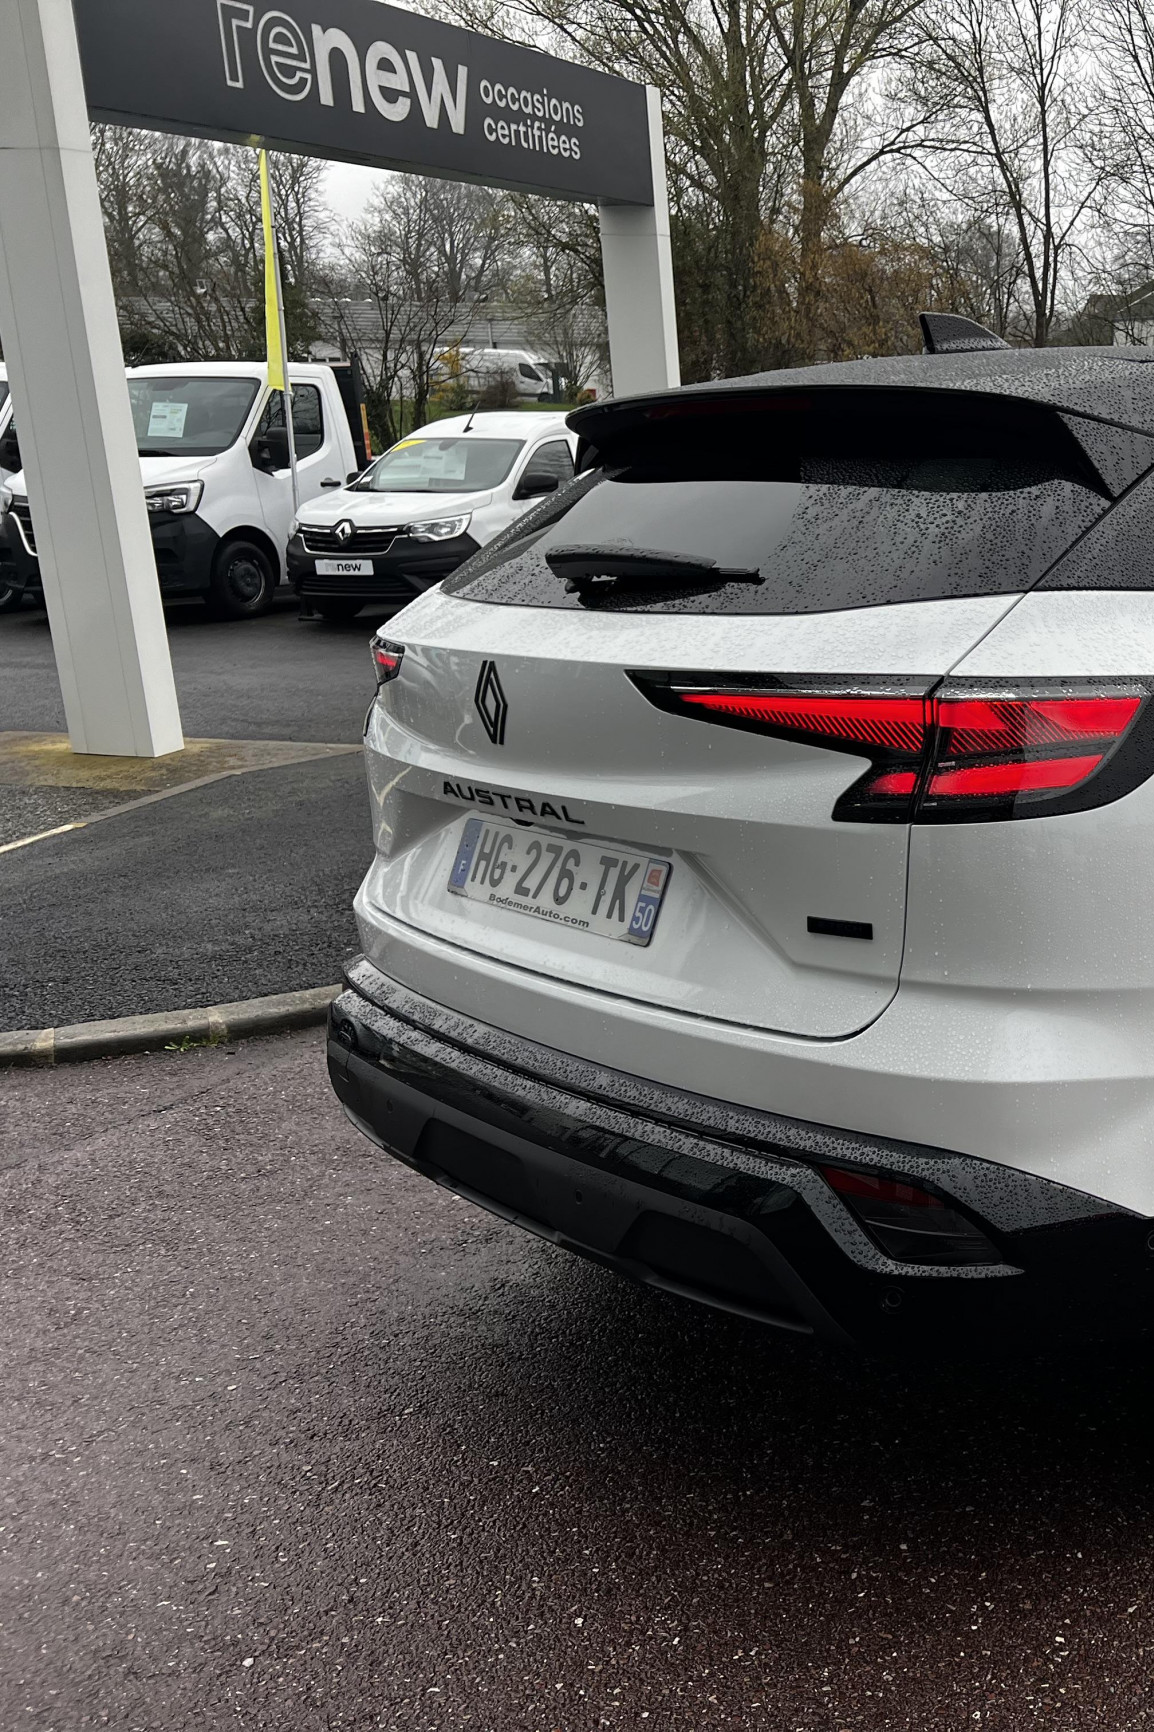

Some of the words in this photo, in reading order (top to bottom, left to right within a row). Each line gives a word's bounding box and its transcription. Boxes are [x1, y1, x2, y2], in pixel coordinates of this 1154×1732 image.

[217, 0, 468, 135] renew
[480, 79, 584, 127] occasions
[484, 117, 581, 160] certifiées
[443, 781, 585, 825] AUSTRAL
[458, 860, 467, 874] F
[470, 828, 640, 922] HG-276-TK
[632, 901, 655, 932] 50
[488, 893, 590, 929] BodemerAuto.com
